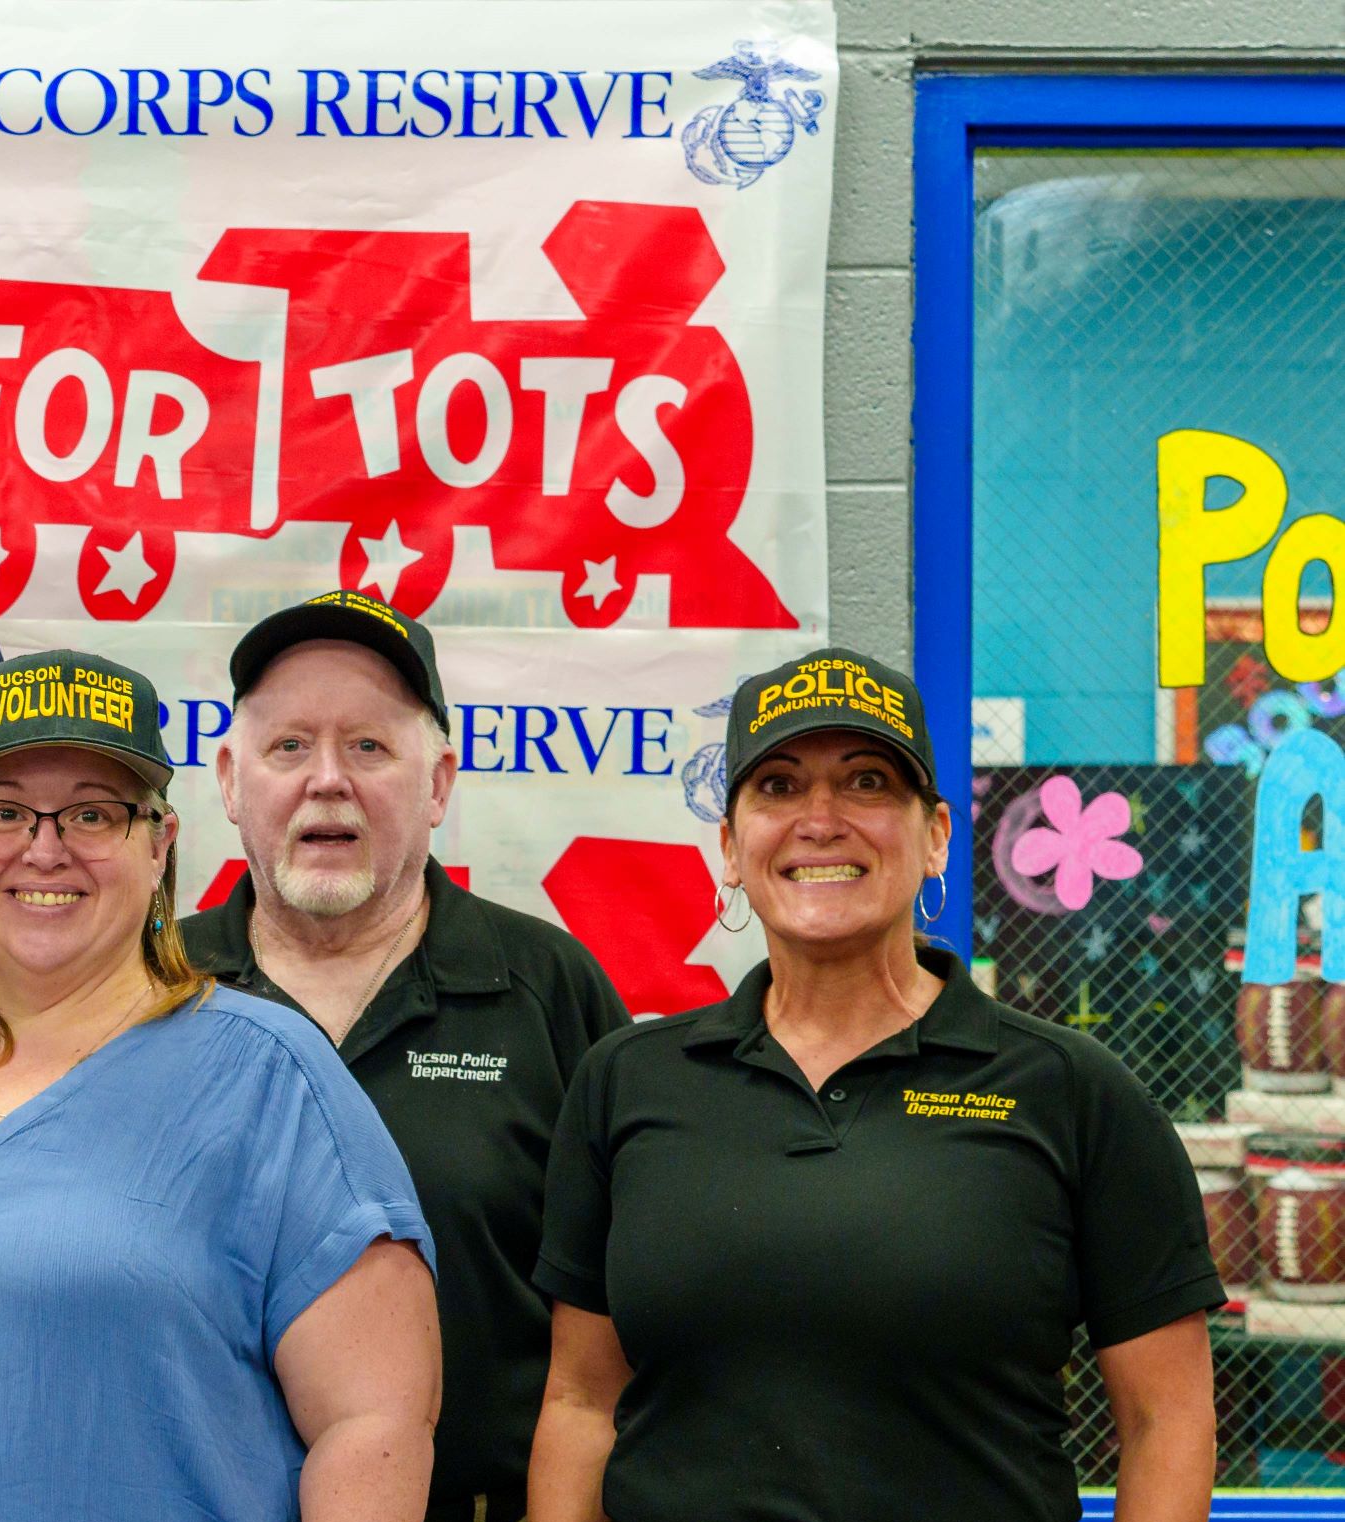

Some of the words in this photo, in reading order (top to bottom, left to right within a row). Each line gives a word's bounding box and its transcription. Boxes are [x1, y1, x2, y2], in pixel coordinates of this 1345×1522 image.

[298, 69, 673, 139] RESERVE
[310, 349, 688, 529] TOTS
[346, 593, 394, 616] POLICE
[798, 660, 867, 677] TUCSON
[75, 668, 133, 695] POLICE
[758, 670, 906, 721] POLICE
[749, 697, 845, 734] COMMUNITY
[849, 698, 914, 739] SERVICES
[454, 703, 674, 777] ERVE
[407, 1050, 458, 1064] Tucson
[461, 1053, 507, 1068] Police
[411, 1064, 503, 1081] Department
[903, 1090, 961, 1104] Tucson
[964, 1093, 1016, 1109] Police
[906, 1102, 1009, 1120] Department
